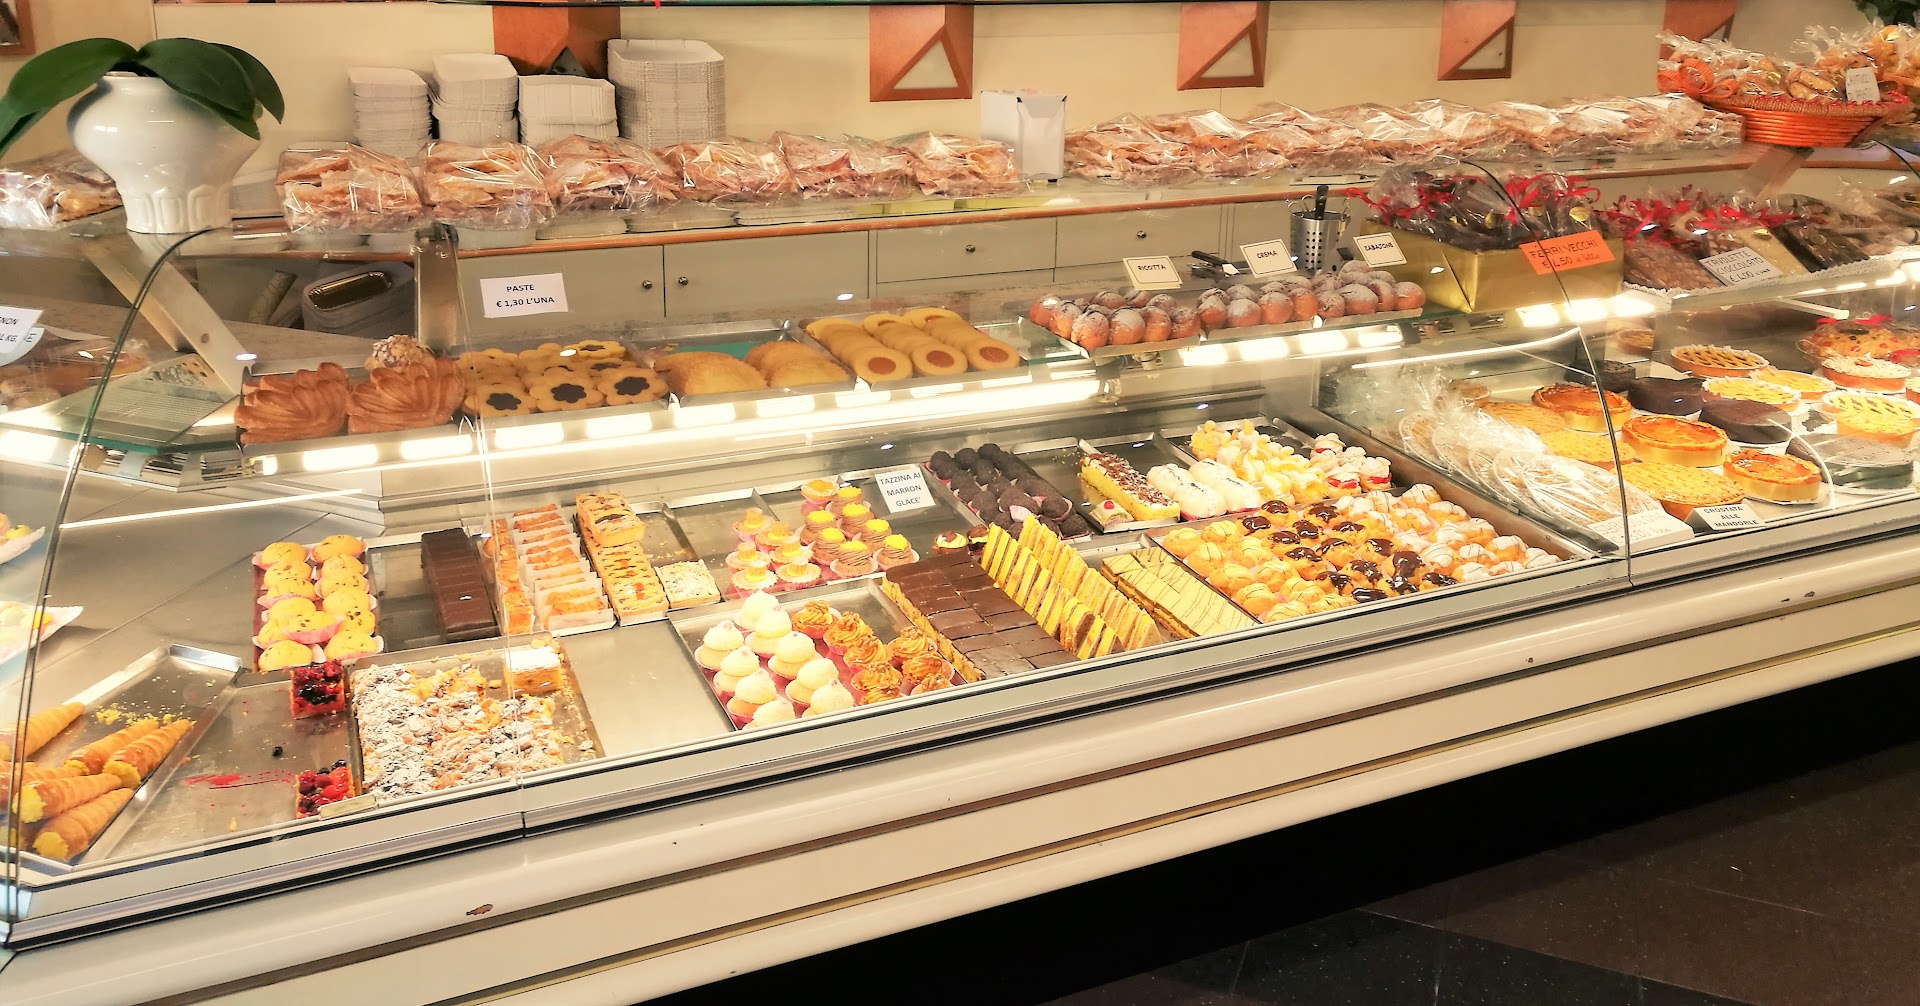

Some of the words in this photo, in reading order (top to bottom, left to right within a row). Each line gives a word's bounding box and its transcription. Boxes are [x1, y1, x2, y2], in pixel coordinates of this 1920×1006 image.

[1256, 250, 1278, 259] CREMA
[1528, 245, 1563, 259] FERRI
[1563, 239, 1598, 253] VECCHI
[1704, 250, 1752, 268] TAVOLETTE
[1716, 256, 1764, 275] CIOCCOLATO
[506, 284, 535, 293] PASTE
[496, 300, 503, 308] €
[504, 299, 524, 307] 1,30
[526, 296, 555, 305] L'UNA
[880, 474, 912, 485] TAZZINA
[886, 485, 922, 496] MARRON
[1703, 506, 1744, 514] CROSTATA
